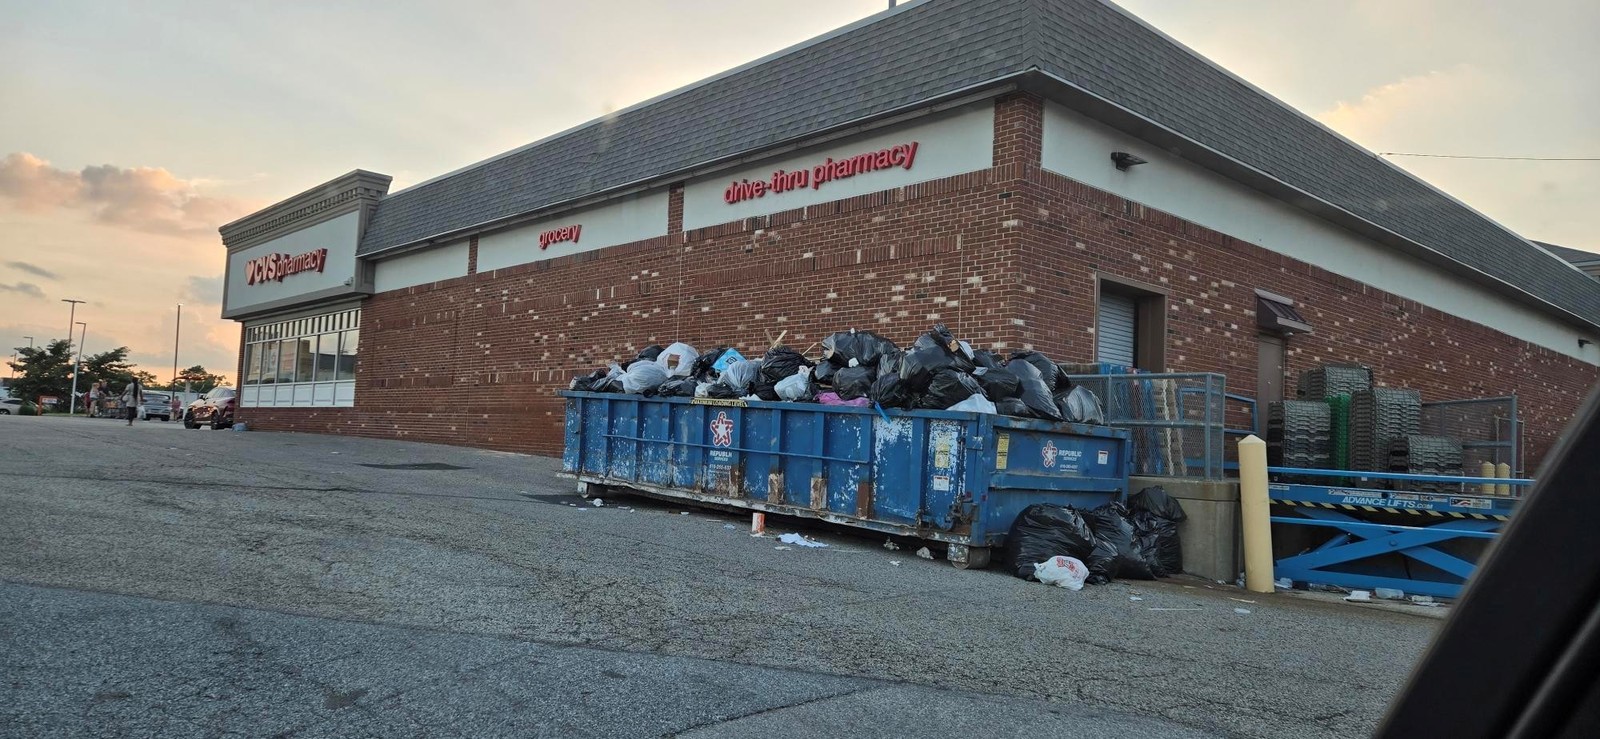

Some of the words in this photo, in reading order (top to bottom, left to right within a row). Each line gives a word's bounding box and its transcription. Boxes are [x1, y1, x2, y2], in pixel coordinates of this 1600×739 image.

[723, 174, 809, 204] drive-thru
[811, 141, 919, 190] pharmacy
[538, 223, 582, 249] grocery
[255, 253, 279, 283] CVS
[277, 248, 328, 282] pharmacy
[1341, 496, 1387, 506] ADVANCE
